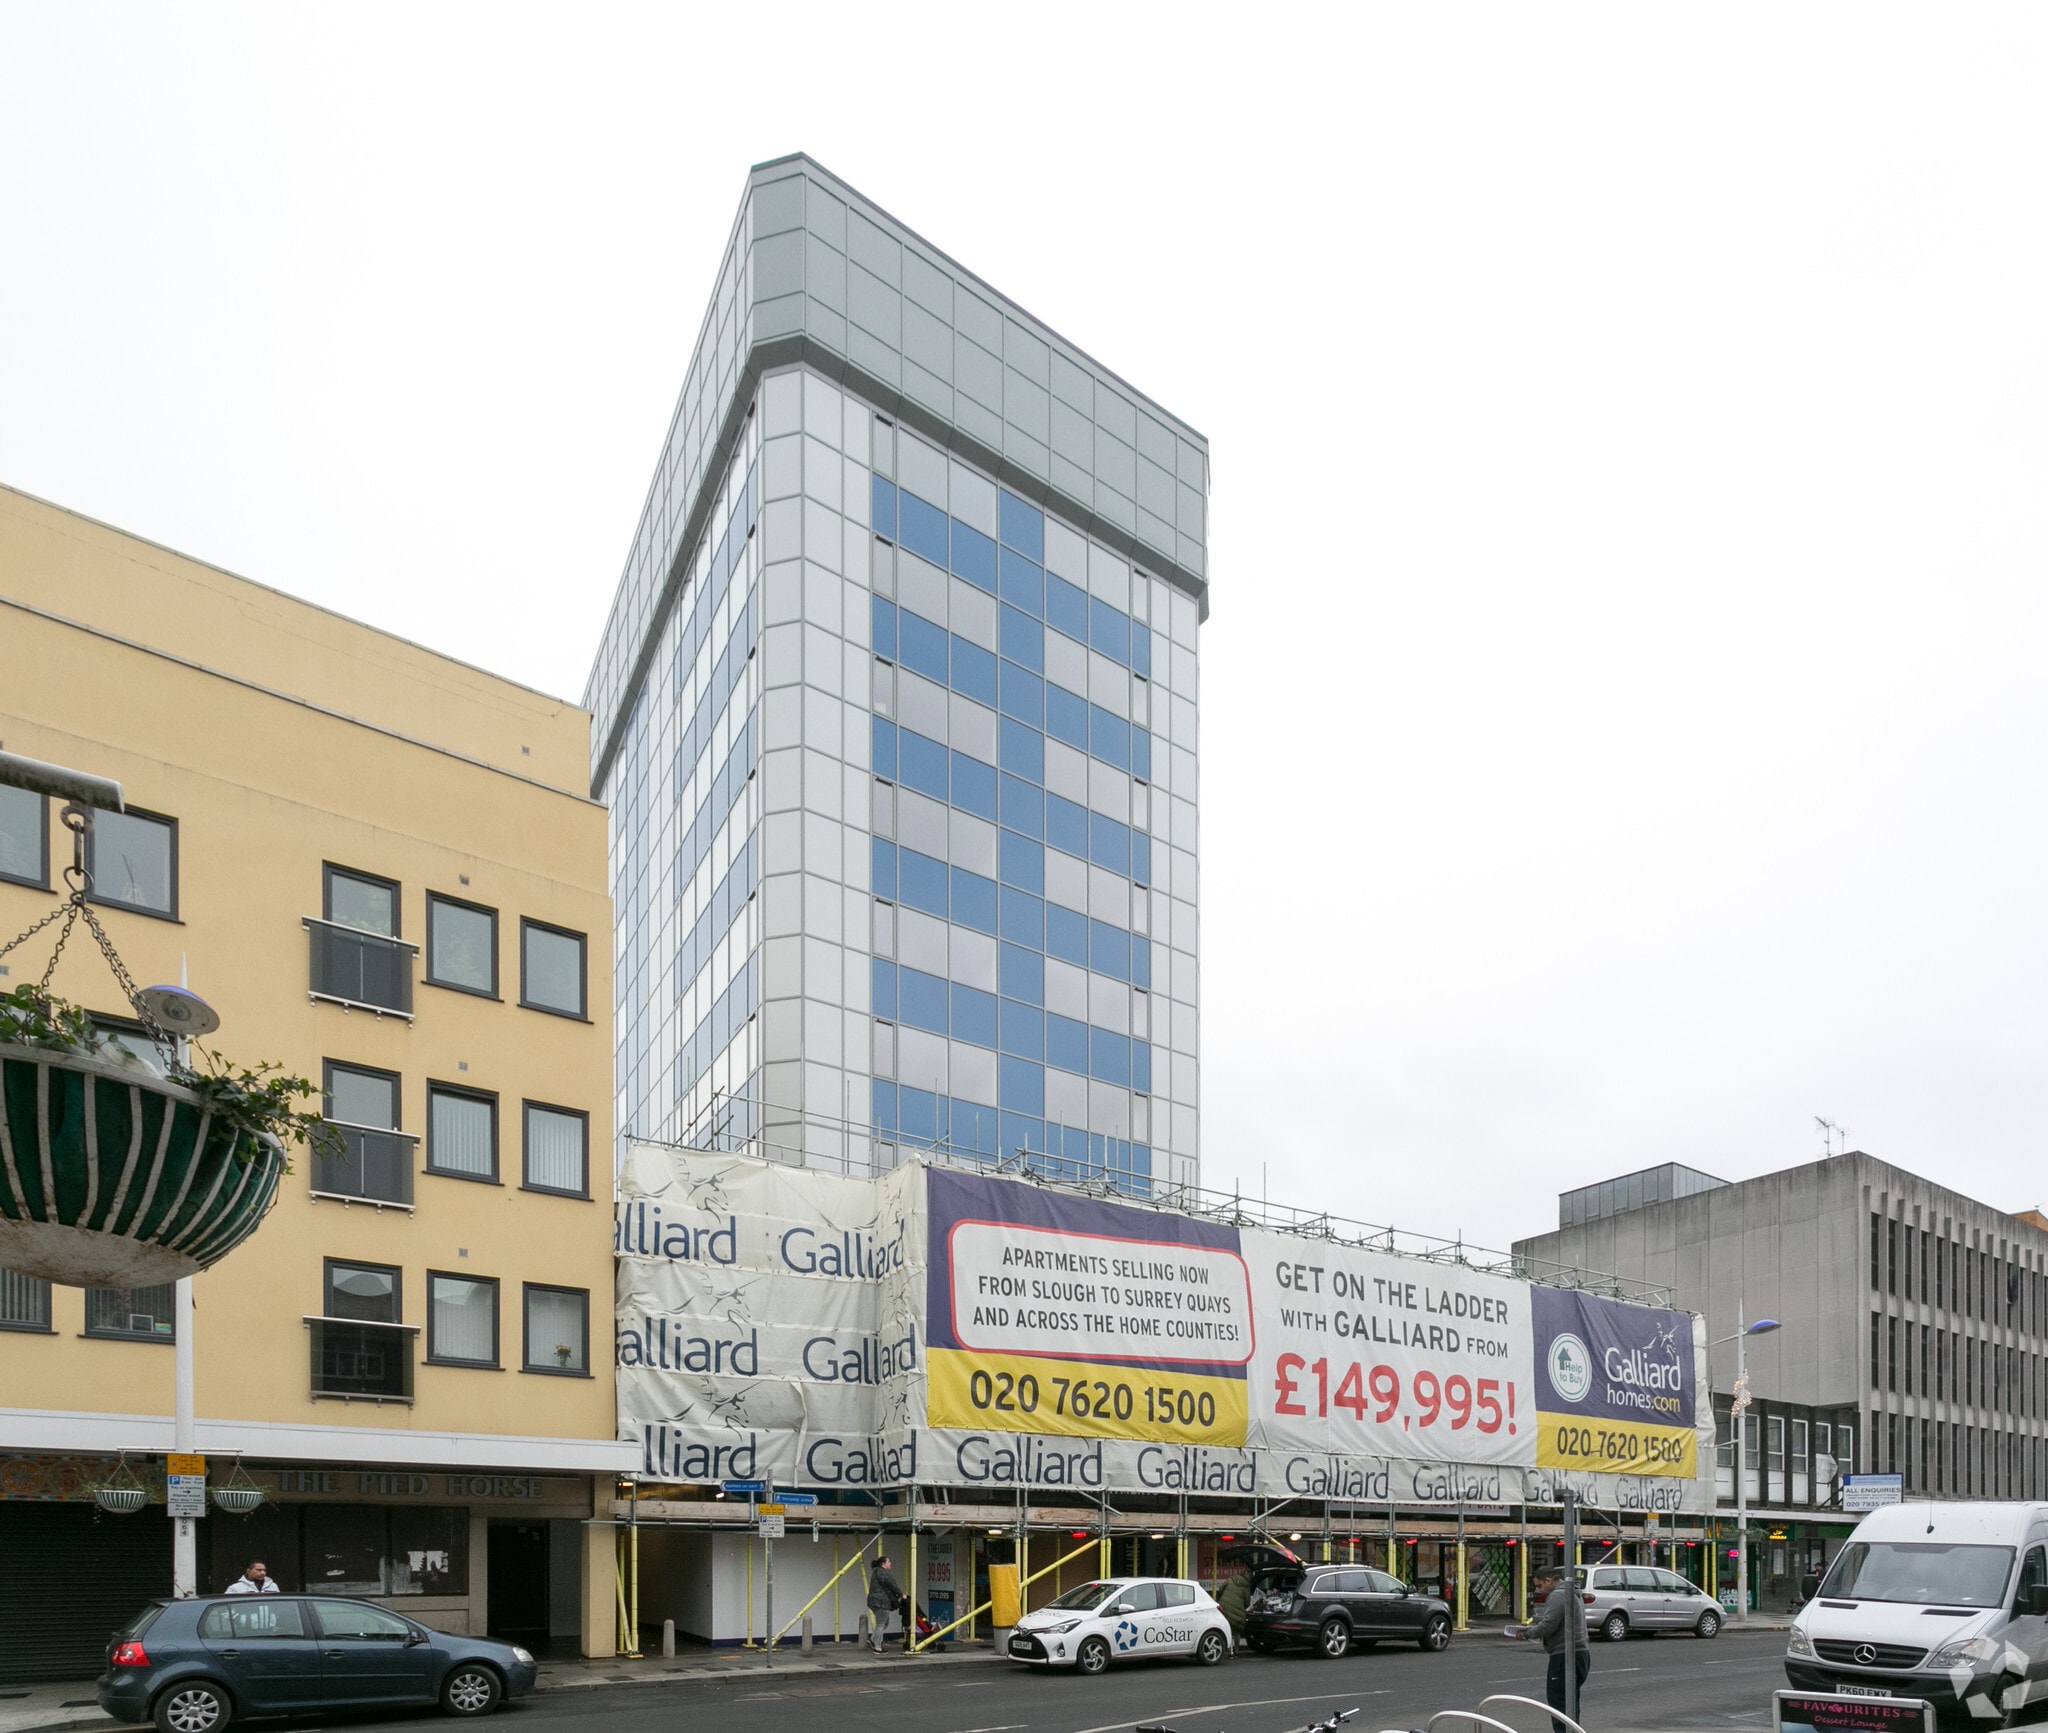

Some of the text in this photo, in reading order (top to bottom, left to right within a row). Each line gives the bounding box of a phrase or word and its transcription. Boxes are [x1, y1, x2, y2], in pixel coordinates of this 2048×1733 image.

[614, 1202, 737, 1265] alliard
[781, 1218, 904, 1279] Galliard
[1002, 1246, 1209, 1285] APARTMENTS SELLING NOW
[978, 1275, 1232, 1314] FROM SLOUGH TO SURREY QUAYS
[1276, 1261, 1508, 1325] GET ON THE LADDER
[973, 1306, 1239, 1342] AND ACROSS THE HOME COUNTIES!
[1280, 1308, 1508, 1359] WITH GALLIARD FROM
[620, 1316, 758, 1377] alliard
[1560, 1370, 1583, 1386] to Buy
[1564, 1361, 1583, 1374] Help
[1605, 1346, 1681, 1391] Galliard
[970, 1370, 1216, 1427] 020 7620 1500
[1275, 1352, 1517, 1436] £149,995!
[1607, 1383, 1681, 1413] homes.com
[621, 1424, 757, 1480] lliard
[957, 1435, 1102, 1486] Galliard
[1557, 1426, 1683, 1463] 020 7620 1500
[275, 1471, 544, 1498] THE PIED HORSE
[1137, 1446, 1257, 1493] Galliard
[1285, 1456, 1390, 1500] Galliard
[1413, 1465, 1500, 1501] Galliard
[1615, 1477, 1683, 1511] Galliard
[1143, 1626, 1194, 1643] CoStar
[1814, 1715, 1888, 1730] Dessert Lounge
